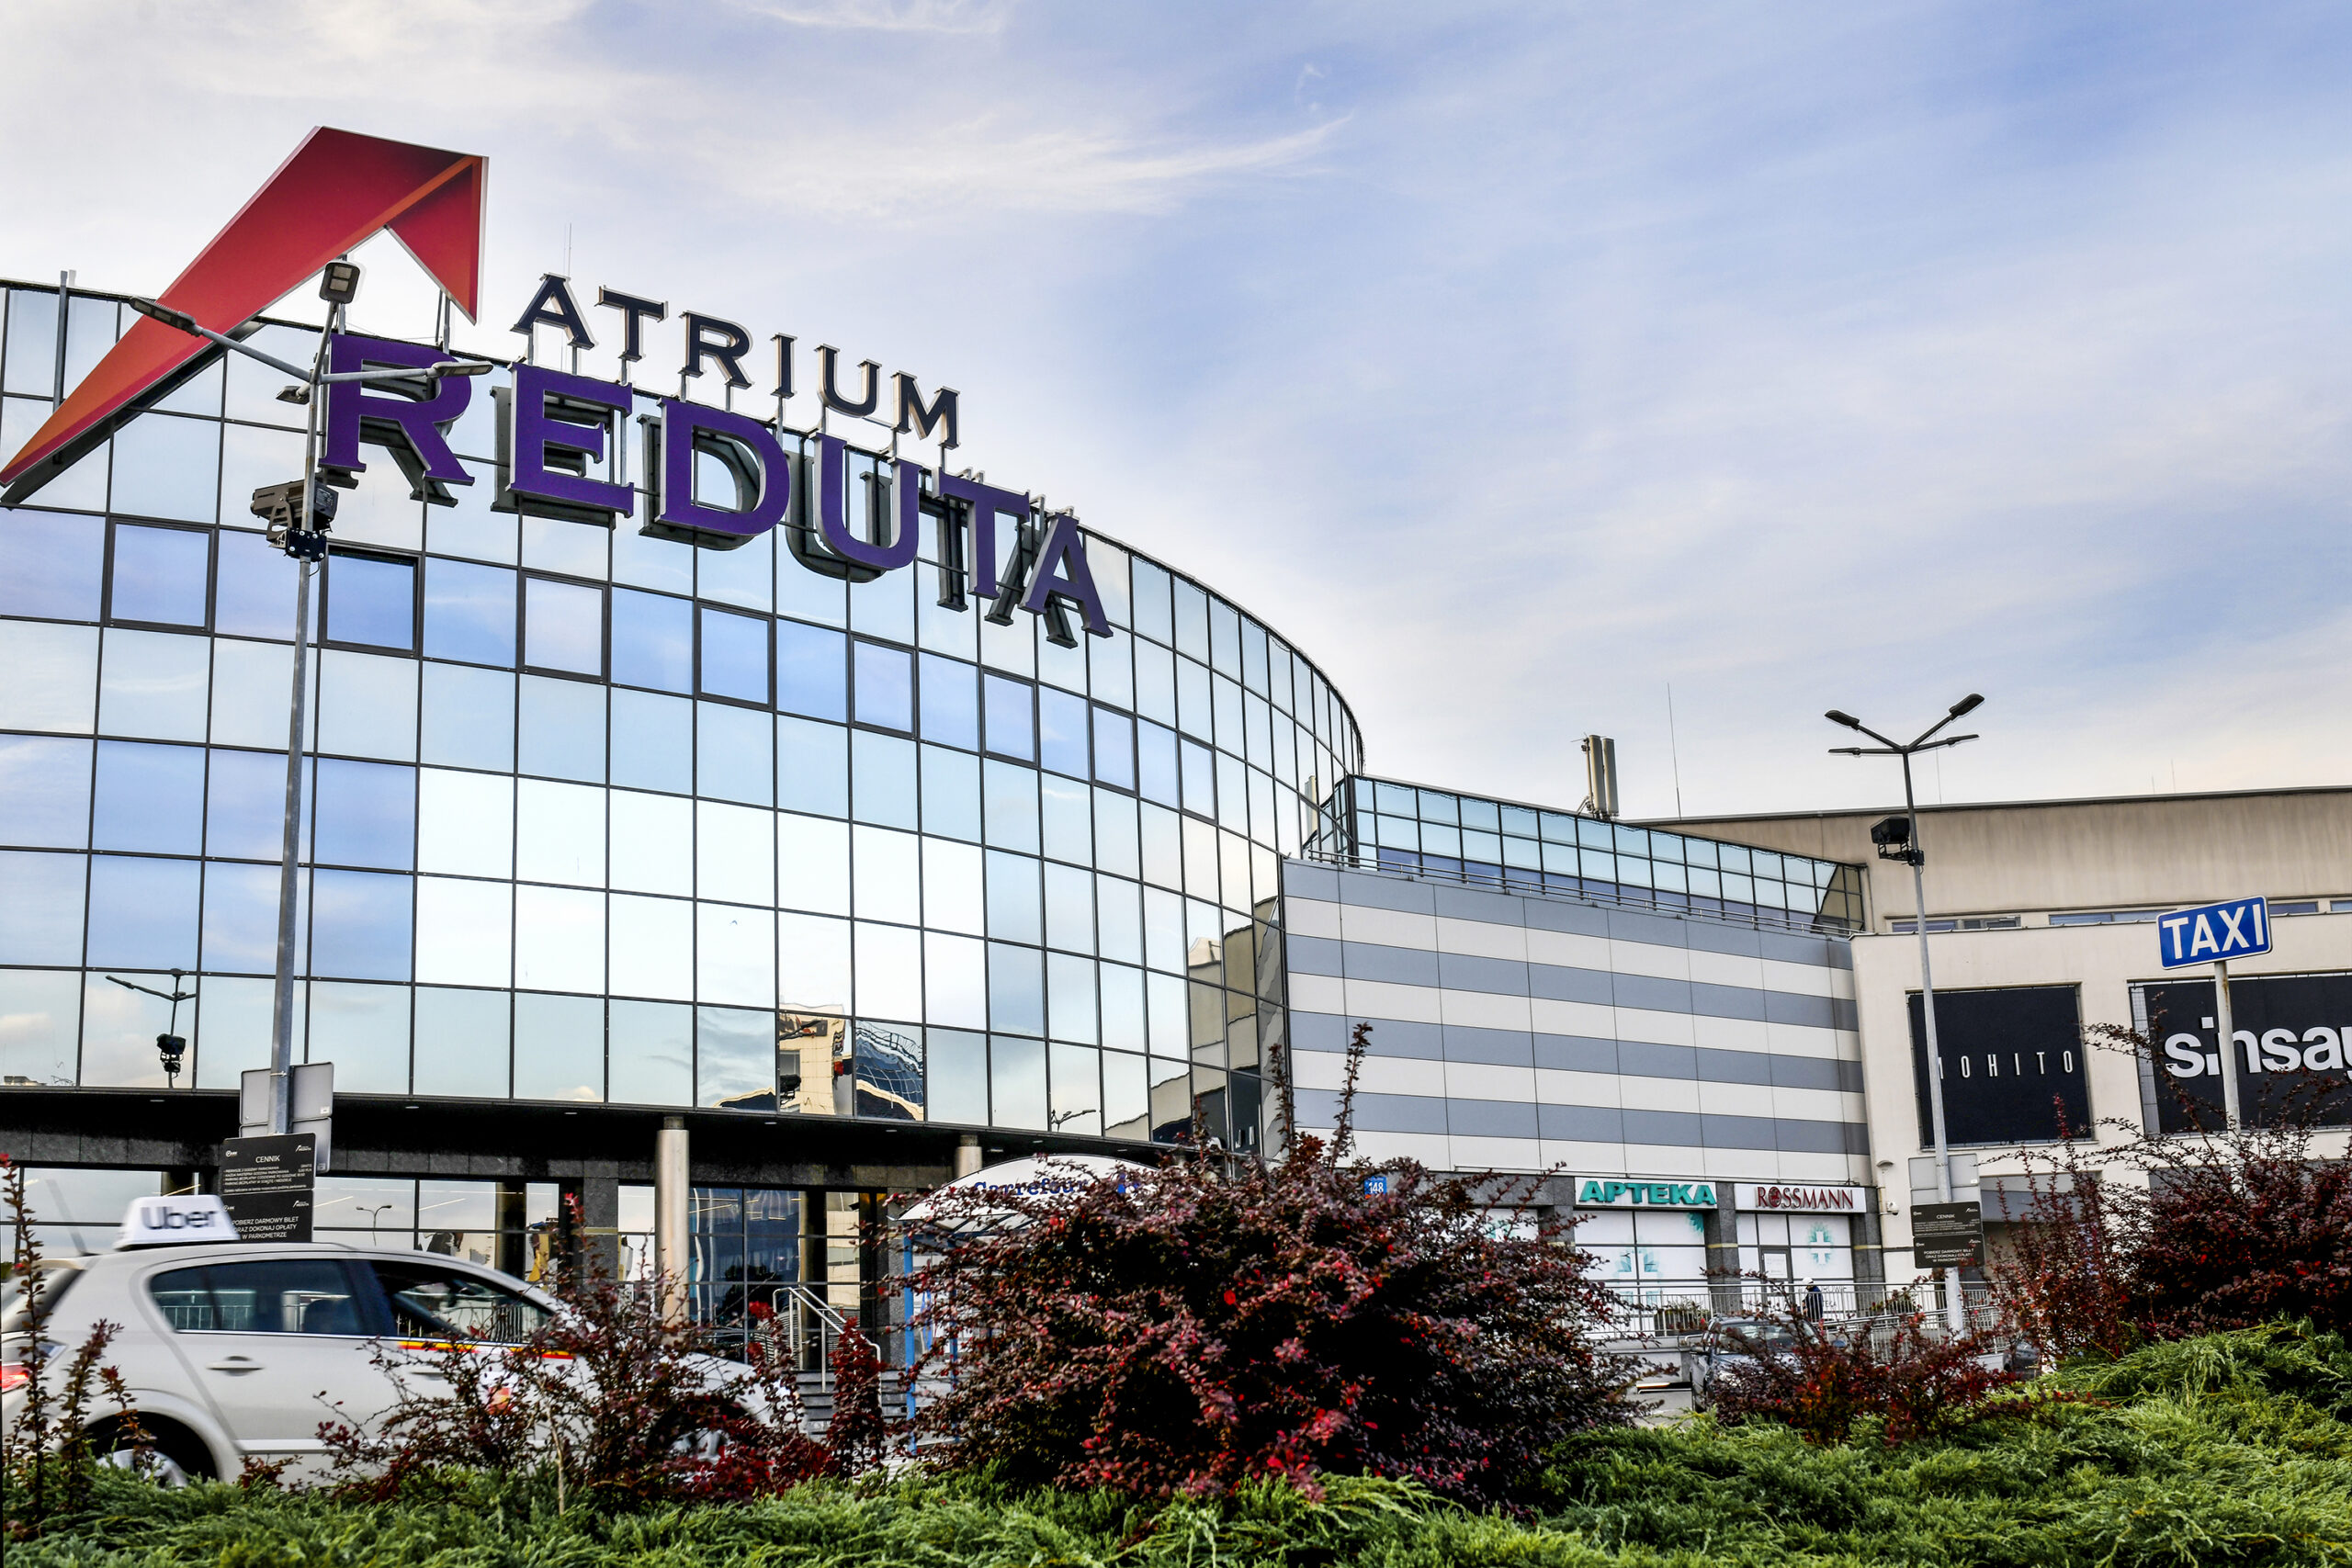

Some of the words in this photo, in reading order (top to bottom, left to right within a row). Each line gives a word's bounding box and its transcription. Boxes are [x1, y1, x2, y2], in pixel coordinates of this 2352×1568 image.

[512, 274, 961, 450] ATRIUM
[318, 333, 1114, 637] REDUTA
[2162, 904, 2265, 959] TAXI
[2165, 1017, 2352, 1080] sinsa
[255, 1155, 280, 1163] CENNIK
[1369, 1182, 1384, 1194] 148
[1579, 1180, 1717, 1205] APTEKA
[1757, 1186, 1854, 1210] ROSSMANN
[141, 1206, 217, 1230] Uber
